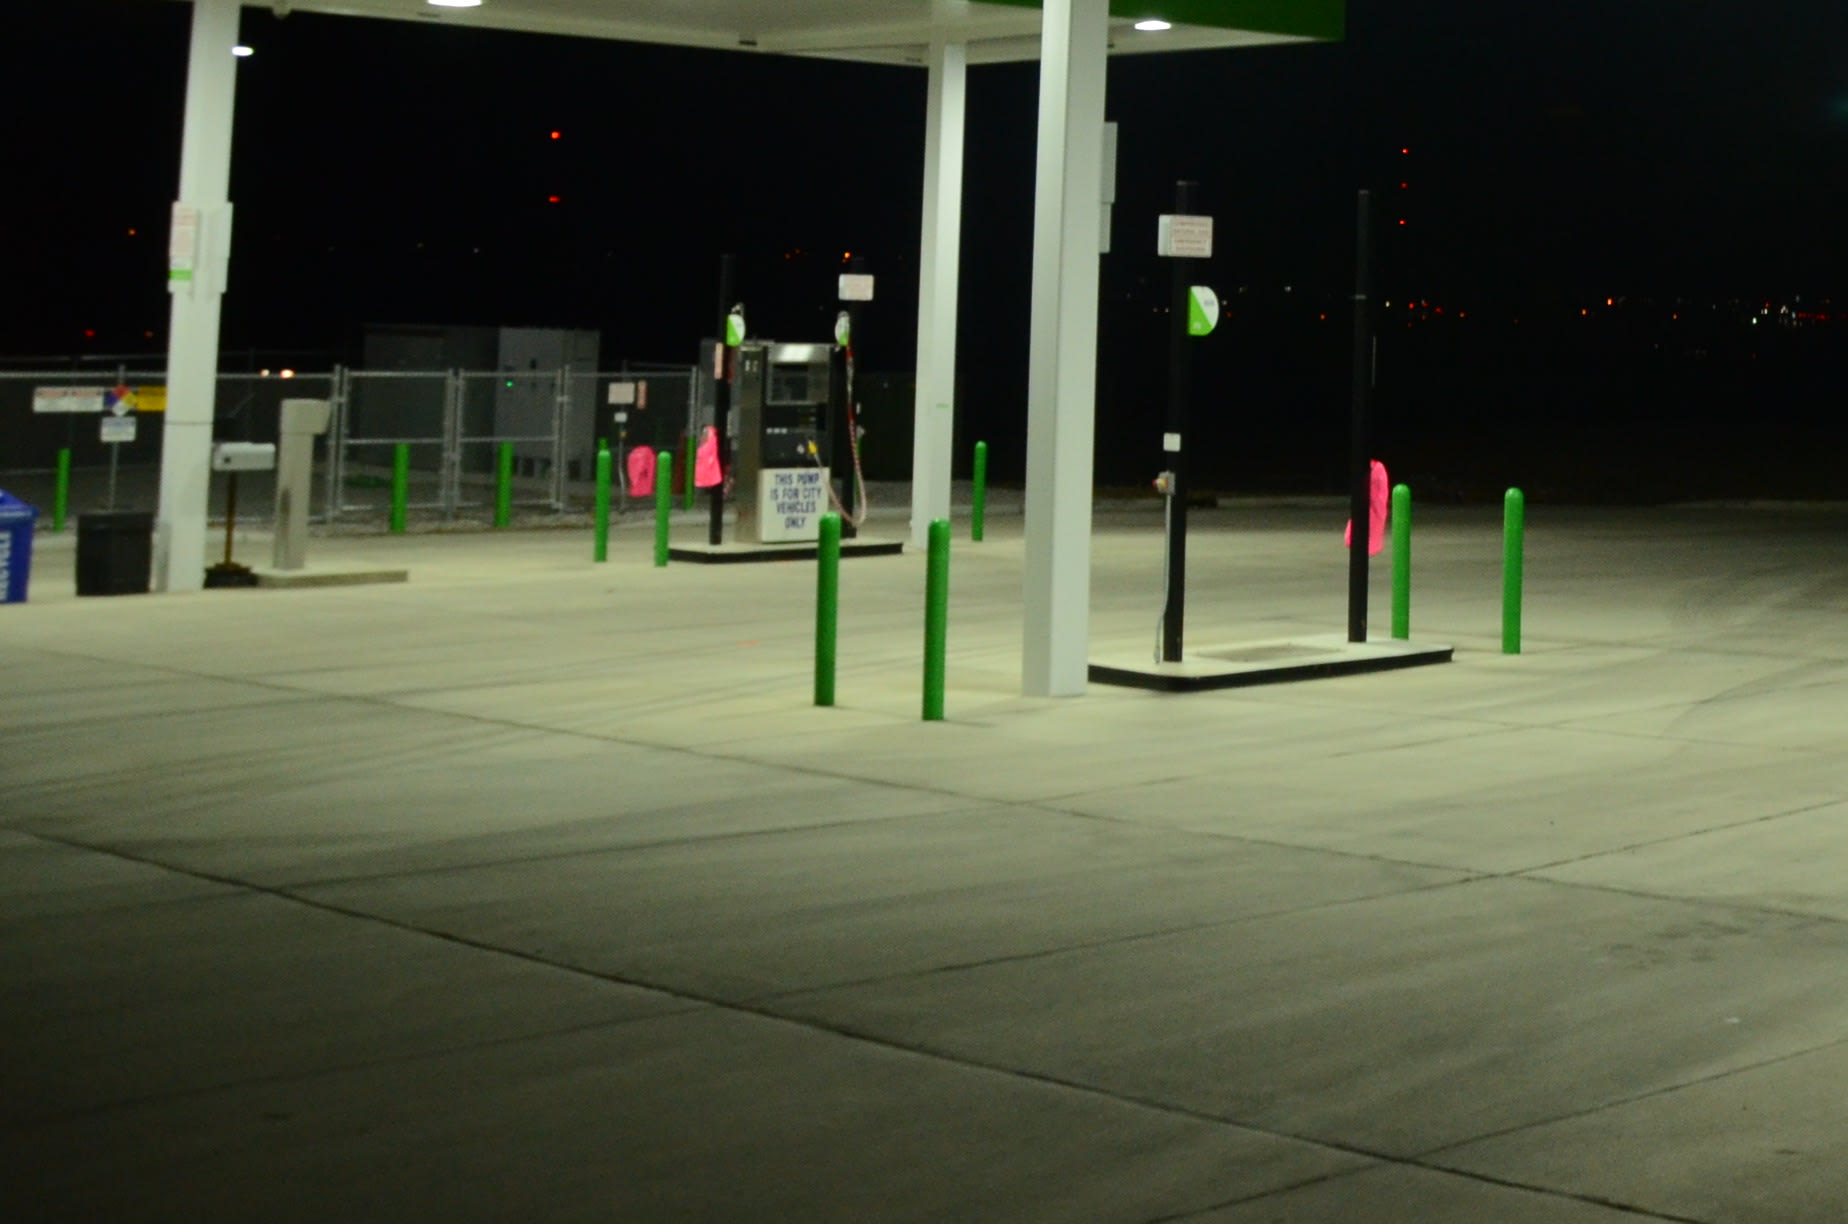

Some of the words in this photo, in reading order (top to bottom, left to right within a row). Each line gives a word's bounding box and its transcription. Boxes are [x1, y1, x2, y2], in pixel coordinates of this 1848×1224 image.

[775, 473, 793, 485] THIS
[797, 473, 819, 485] PUMP
[770, 487, 779, 500] IS
[782, 487, 799, 499] FOR
[802, 487, 822, 499] CITY
[776, 501, 817, 514] VEHICLES
[784, 516, 807, 529] ONLY
